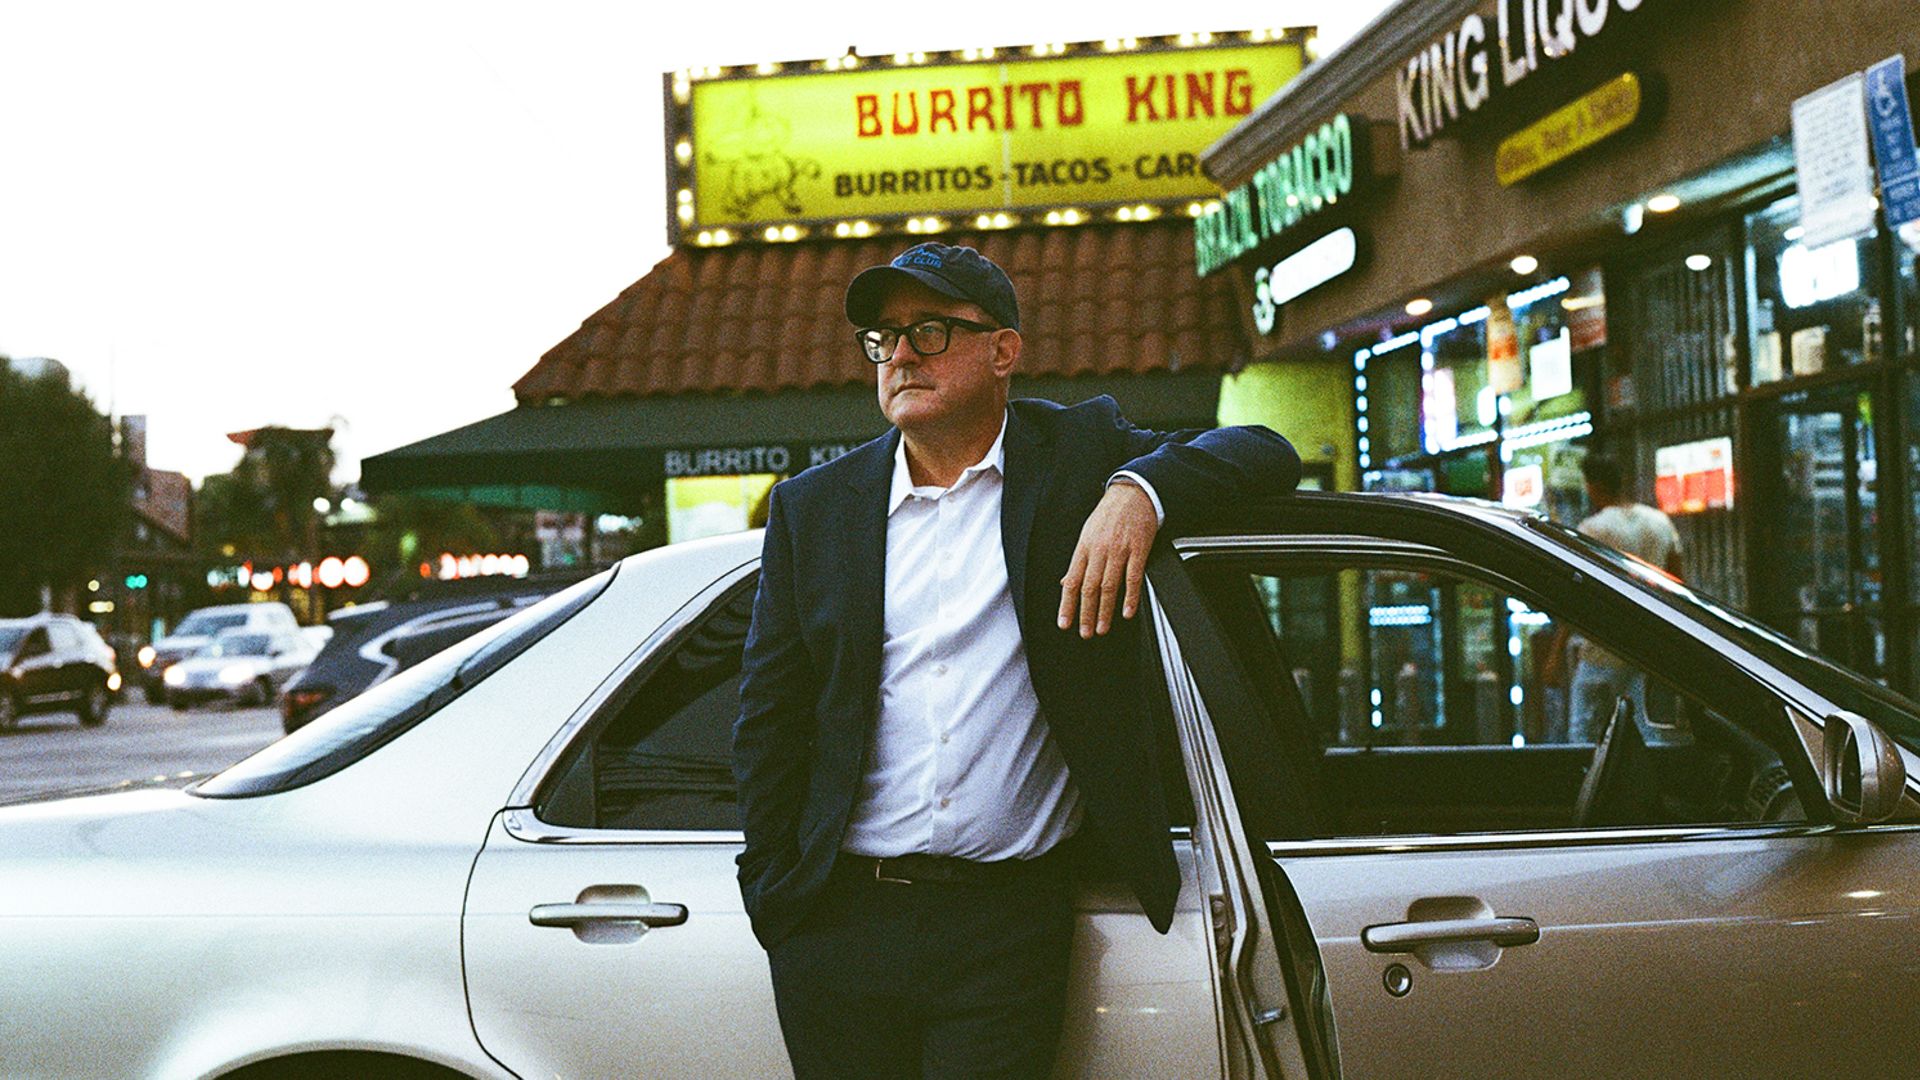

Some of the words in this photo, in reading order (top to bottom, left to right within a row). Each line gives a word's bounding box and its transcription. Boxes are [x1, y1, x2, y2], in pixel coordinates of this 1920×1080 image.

[856, 80, 1084, 138] BURRITO
[1125, 69, 1254, 122] KING
[1396, 14, 1489, 150] KING
[834, 165, 993, 197] BURRITOS
[1013, 158, 1112, 187] TACOS
[1133, 152, 1208, 180] CAR
[665, 447, 790, 475] BURRITO
